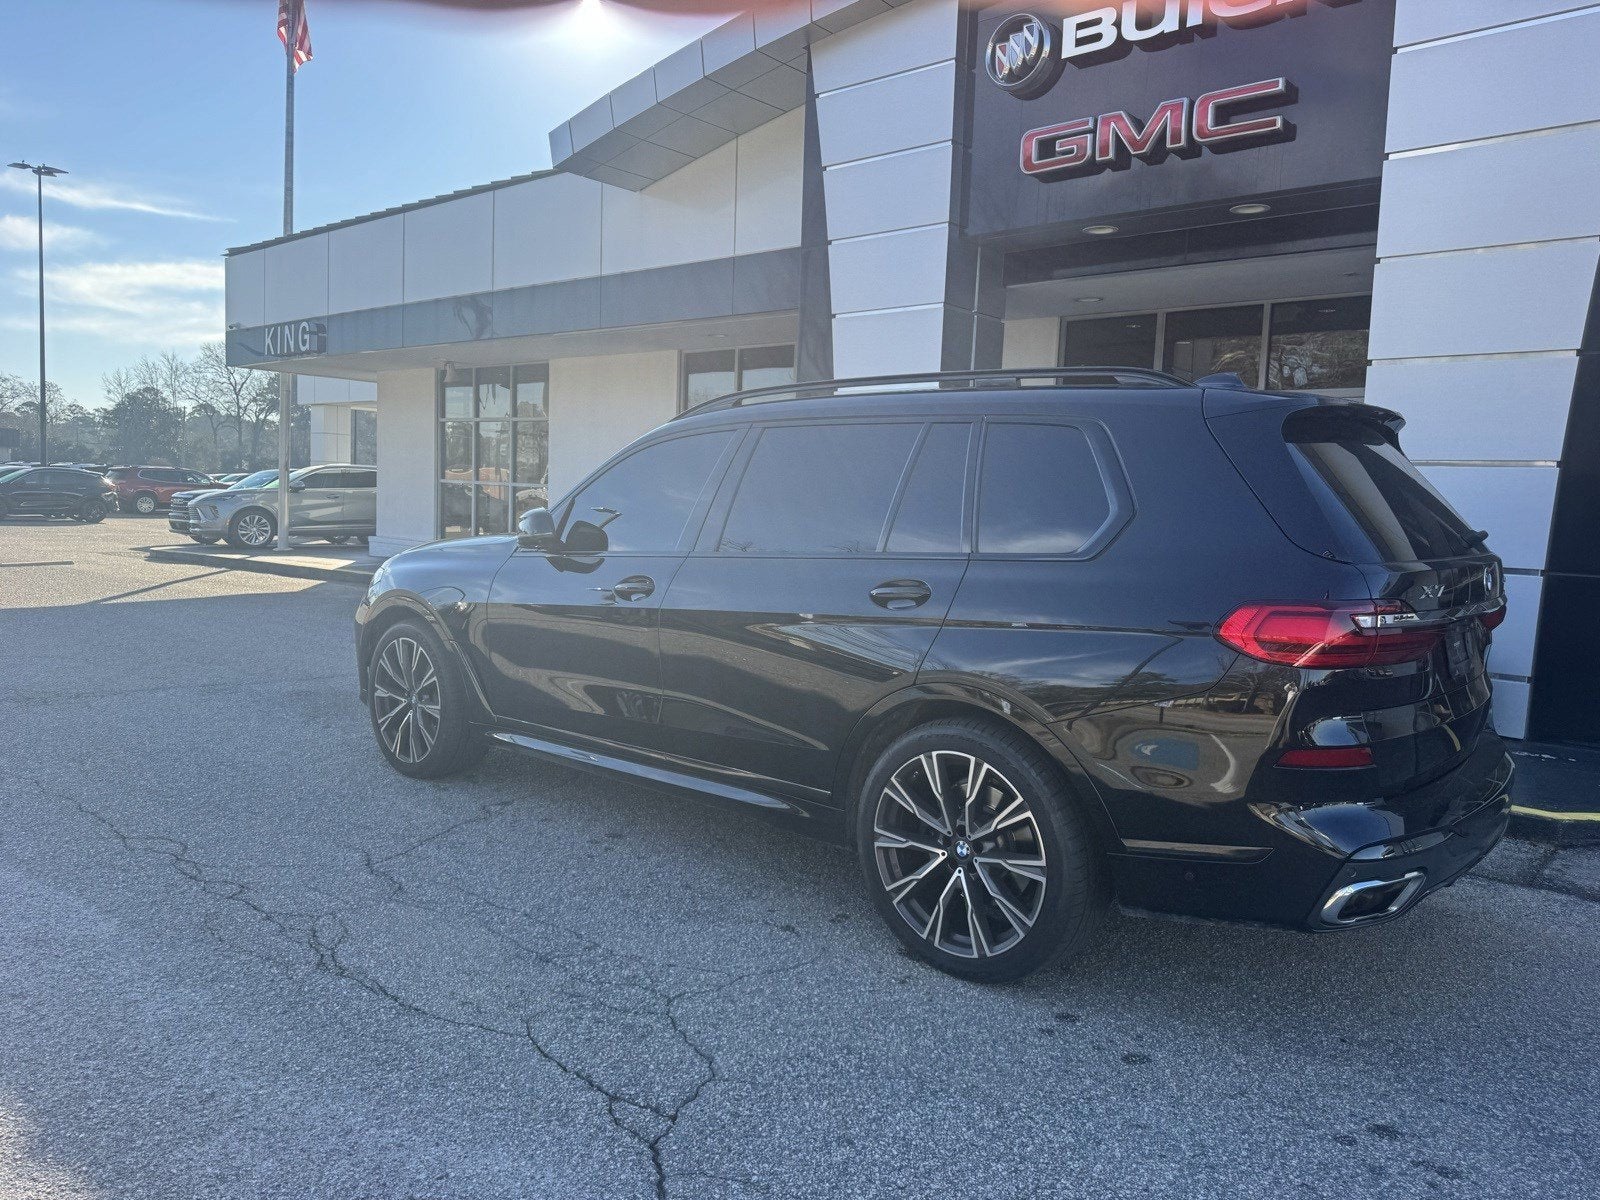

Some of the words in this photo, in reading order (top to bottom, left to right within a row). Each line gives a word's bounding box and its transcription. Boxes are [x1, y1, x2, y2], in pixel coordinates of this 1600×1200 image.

[1061, 0, 1294, 59] BUI
[1019, 76, 1286, 176] GMC
[264, 321, 310, 356] KING
[1418, 584, 1446, 600] X7
